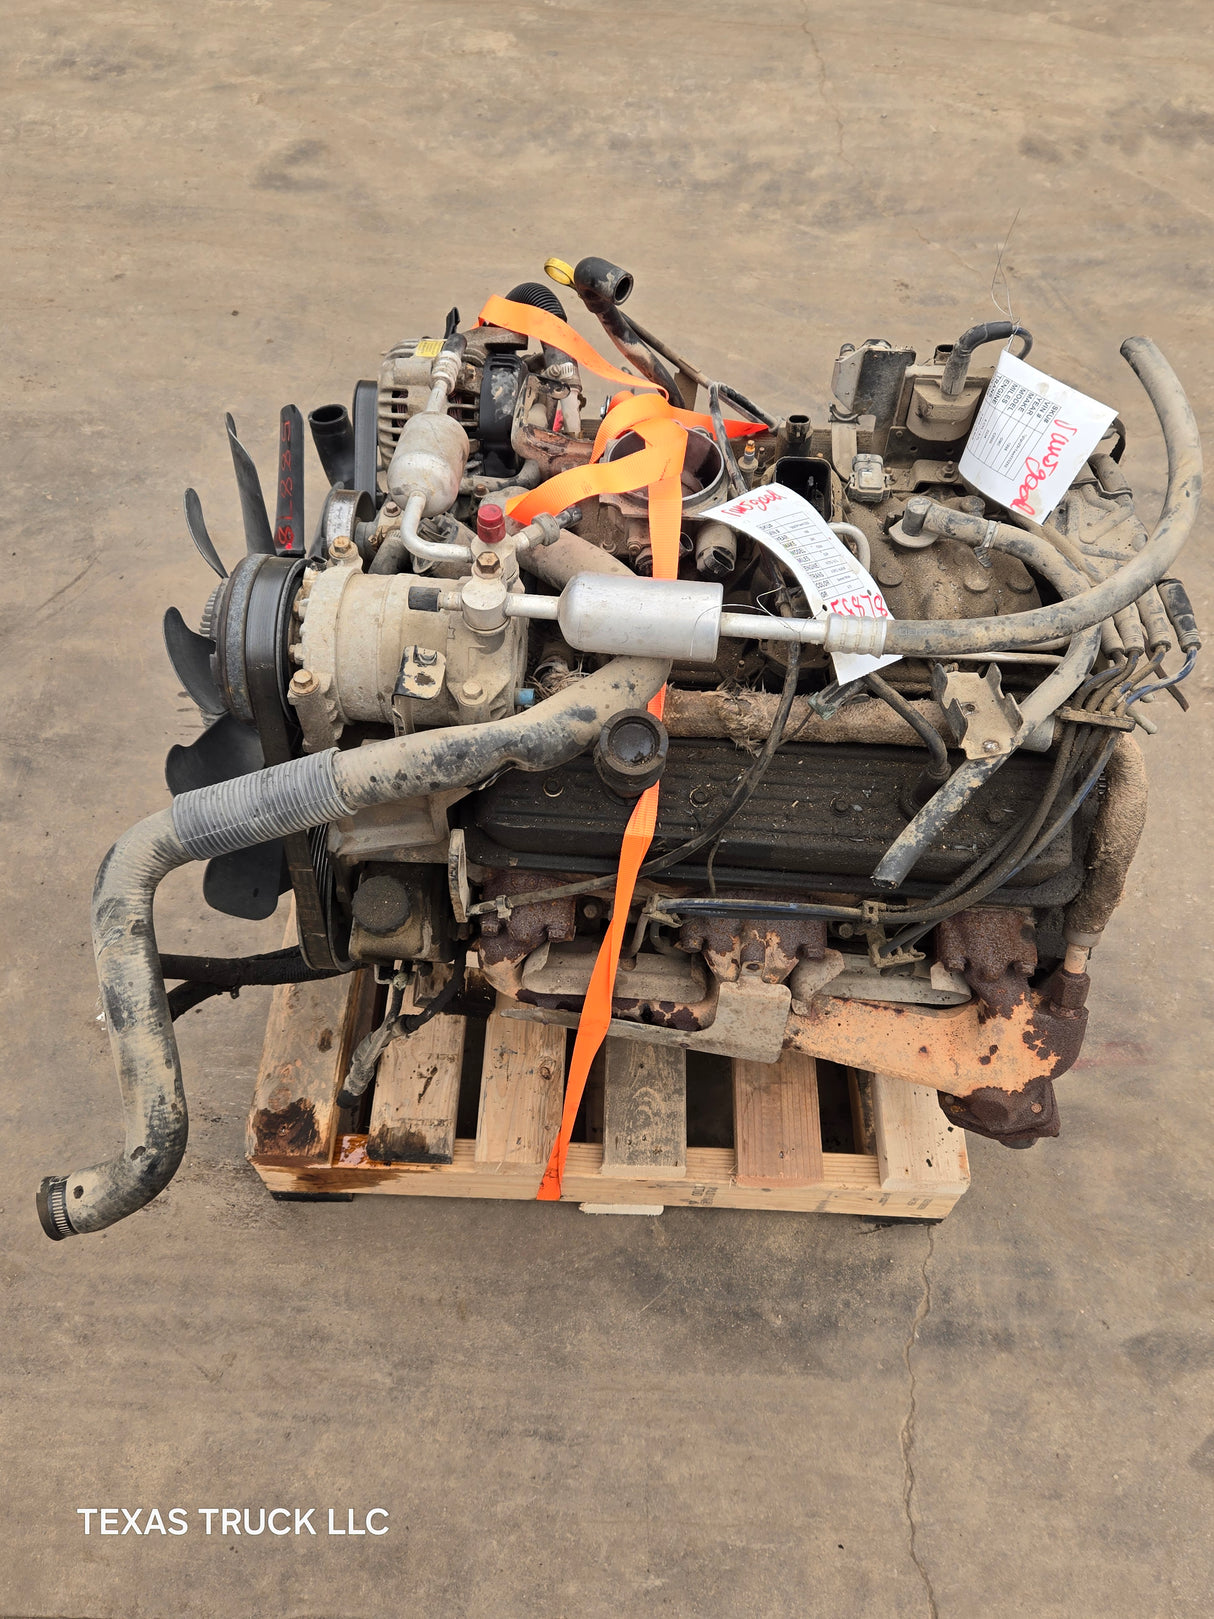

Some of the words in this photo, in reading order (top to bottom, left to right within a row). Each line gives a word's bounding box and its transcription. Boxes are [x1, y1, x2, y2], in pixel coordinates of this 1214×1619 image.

[992, 379, 1010, 405] ENGINE
[1002, 383, 1018, 404] MILES
[1007, 388, 1026, 411] MODEL
[1019, 393, 1034, 413] MAKE
[1027, 397, 1042, 416] YEAR
[1039, 401, 1051, 414] VIN
[1043, 405, 1059, 424] SKU#
[1010, 456, 1047, 516] good
[803, 562, 820, 571] ENGINE
[815, 580, 830, 589] COLOR
